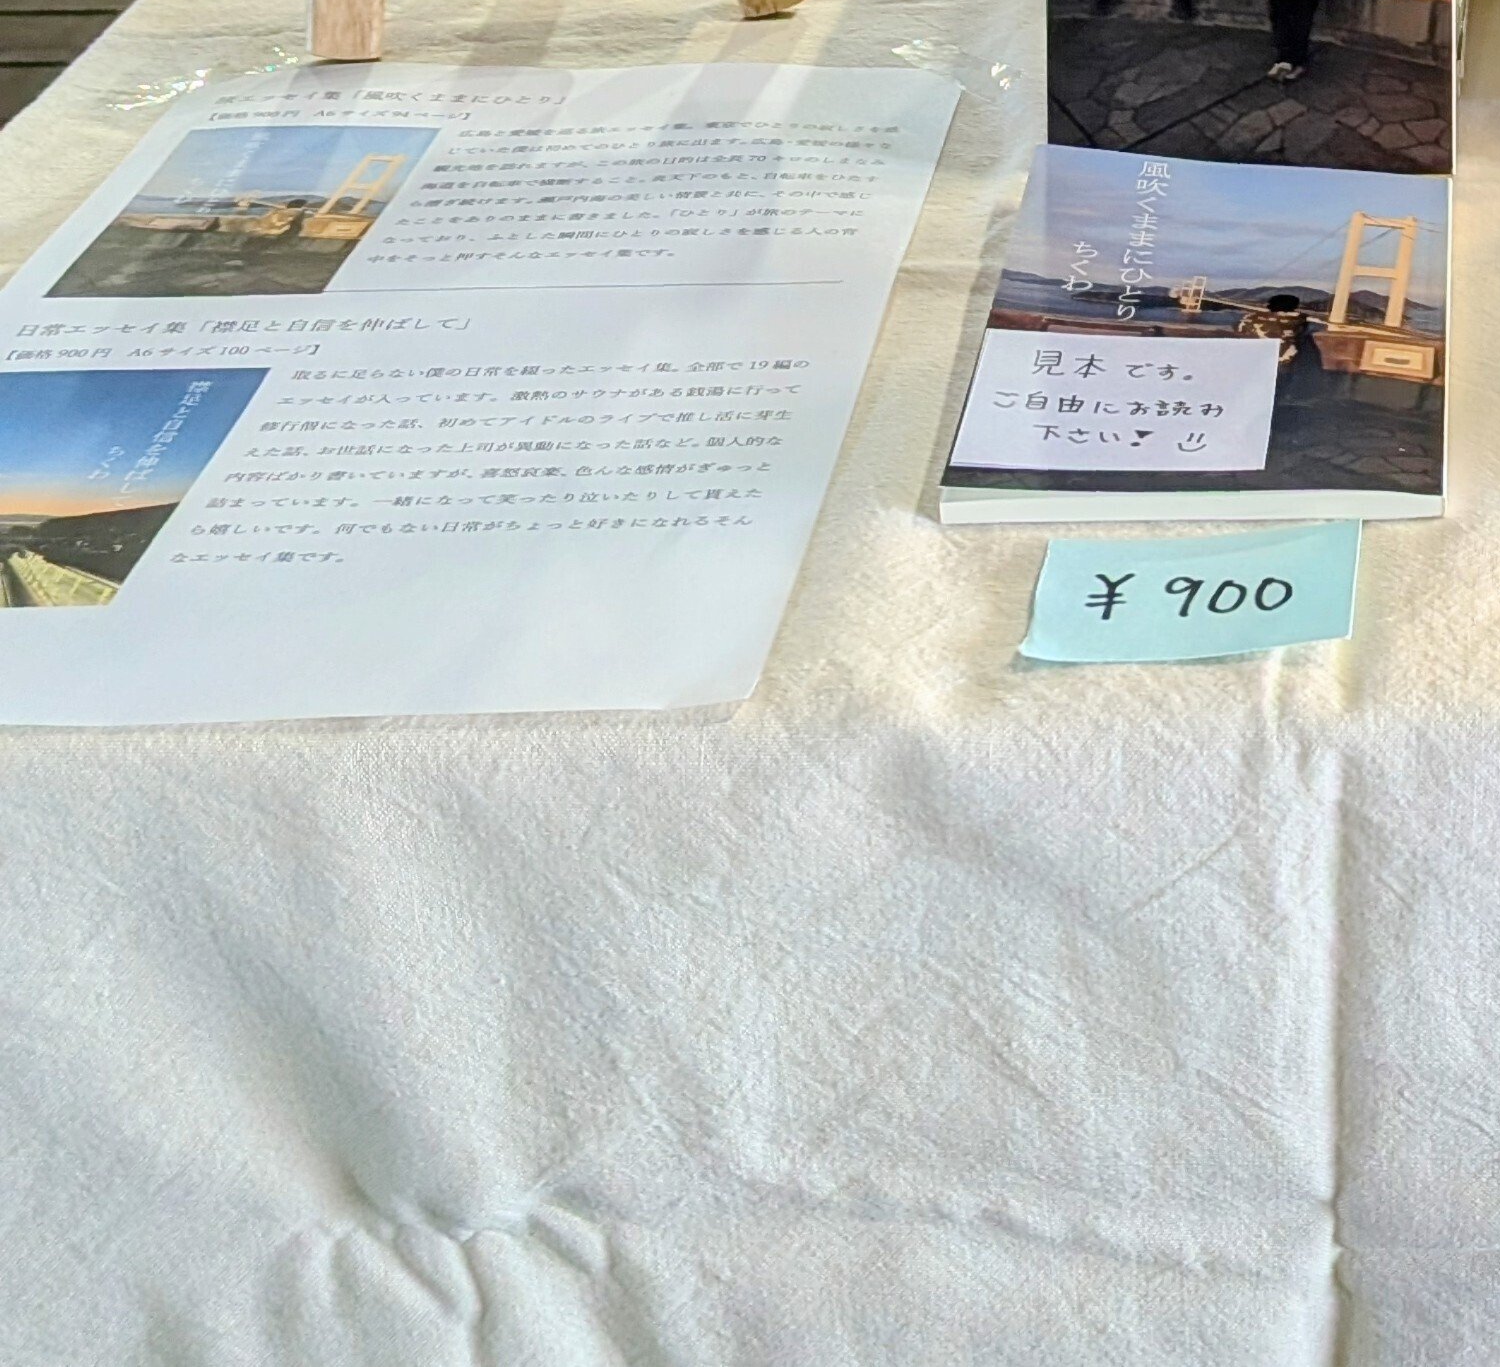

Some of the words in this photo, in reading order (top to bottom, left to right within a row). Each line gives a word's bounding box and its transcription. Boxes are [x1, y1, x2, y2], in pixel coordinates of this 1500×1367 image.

[1115, 160, 1171, 322] 風吹くままにひとり
[1060, 239, 1099, 293] ちくわ
[1031, 349, 1194, 382] 見本です。
[993, 390, 1225, 420] ご自由にお読み
[170, 549, 345, 565] なエッセイ集です。
